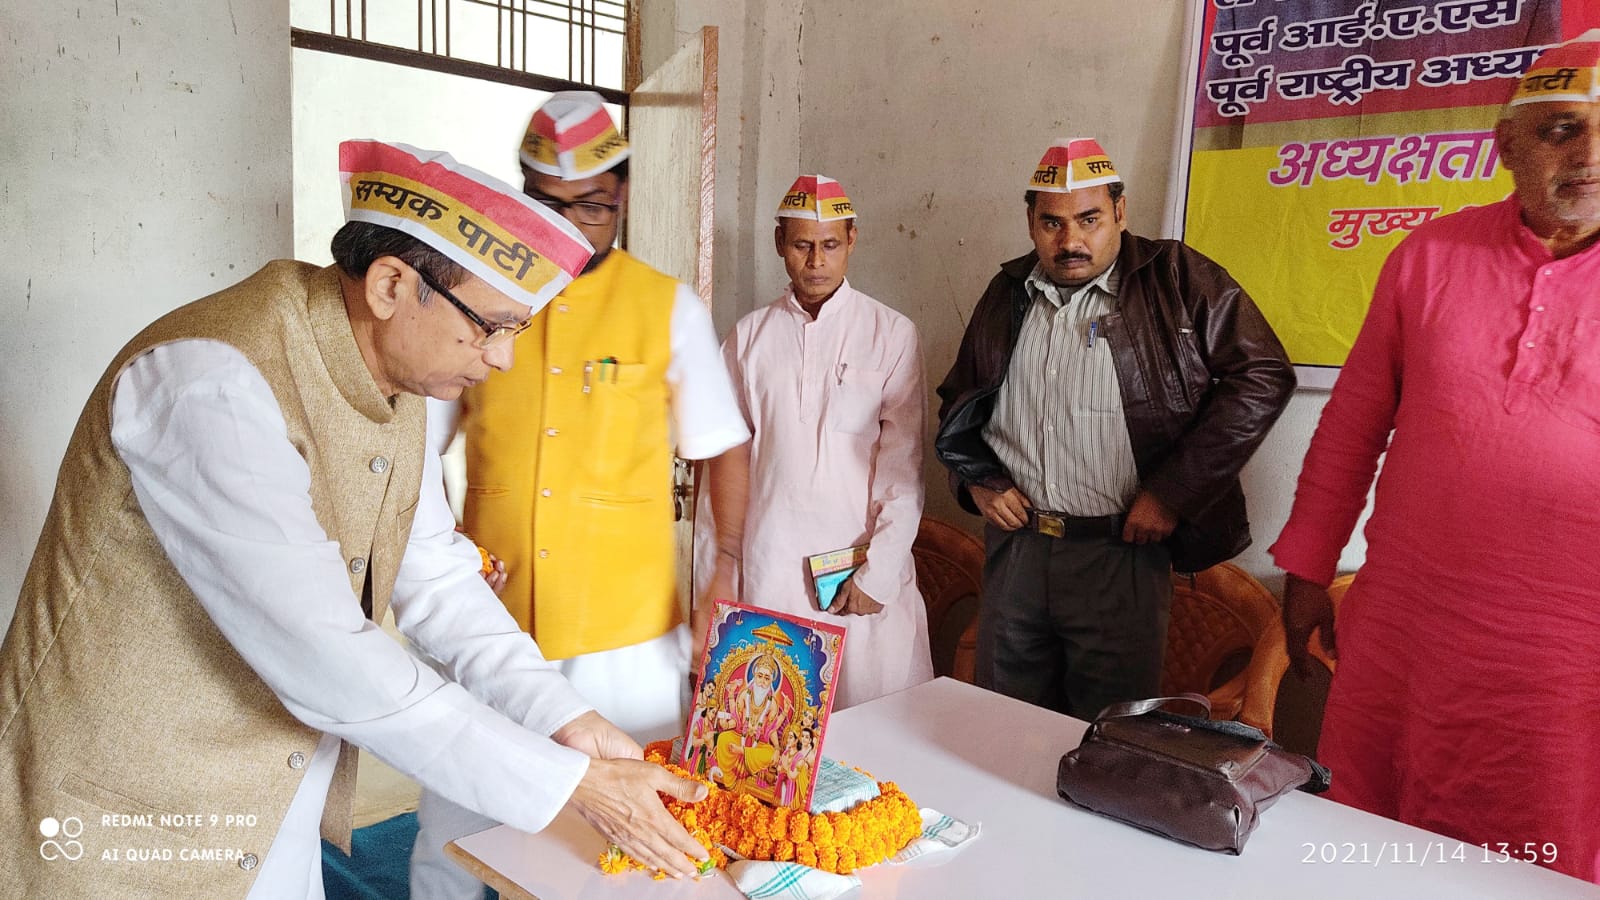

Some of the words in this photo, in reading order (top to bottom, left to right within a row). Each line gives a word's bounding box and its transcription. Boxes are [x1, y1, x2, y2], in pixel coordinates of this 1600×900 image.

[1212, 17, 1277, 68] पूर्व
[1207, 66, 1273, 115] पूर्व
[1277, 57, 1414, 103] राष्ट्रीय
[1419, 48, 1544, 84] अध्य
[1268, 130, 1500, 187] अध्यक्षता
[355, 179, 450, 222] सम्यक
[458, 214, 540, 281] पार्टी
[1328, 206, 1441, 249] मुख्य
